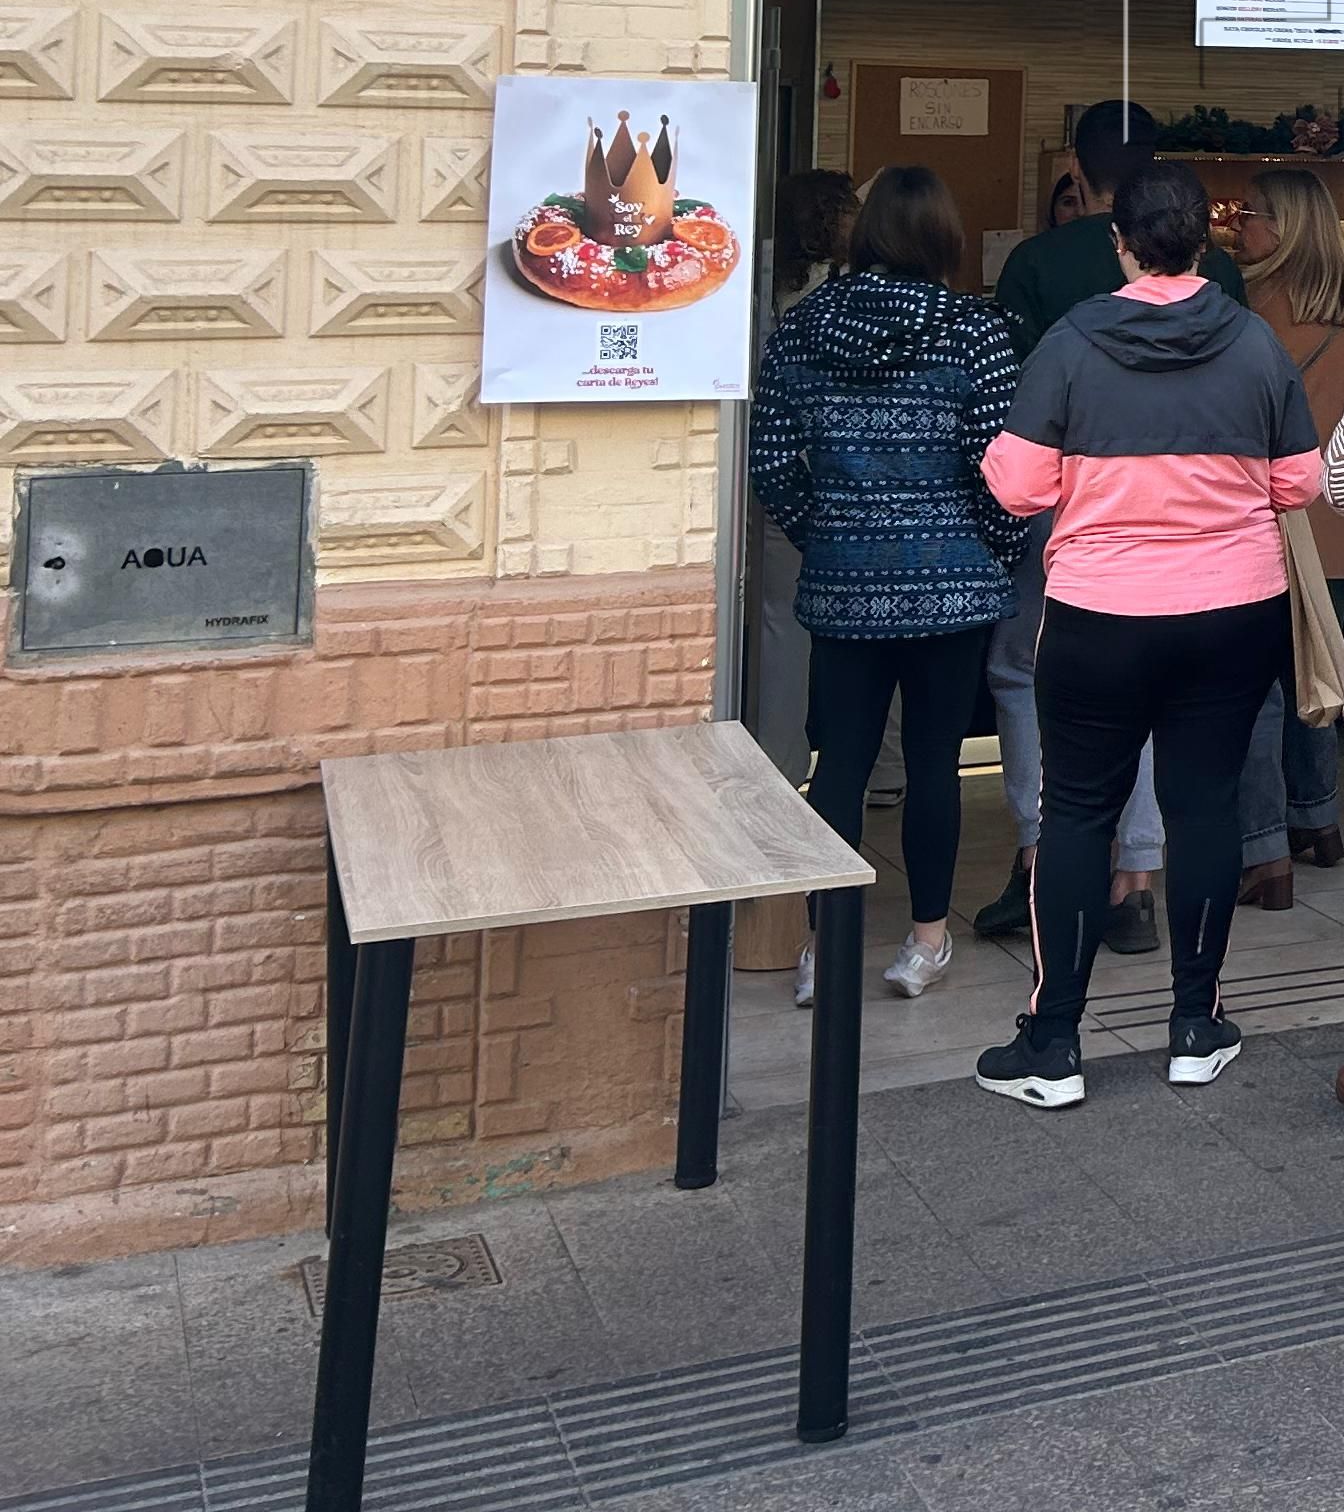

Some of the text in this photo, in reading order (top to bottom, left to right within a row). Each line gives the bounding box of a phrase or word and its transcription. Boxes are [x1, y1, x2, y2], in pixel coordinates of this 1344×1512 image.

[924, 101, 952, 115] SIN
[614, 198, 643, 216] Soy
[622, 213, 634, 224] el
[613, 221, 645, 238] Rey
[607, 377, 622, 387] de
[205, 614, 270, 628] HYDRAFIX
